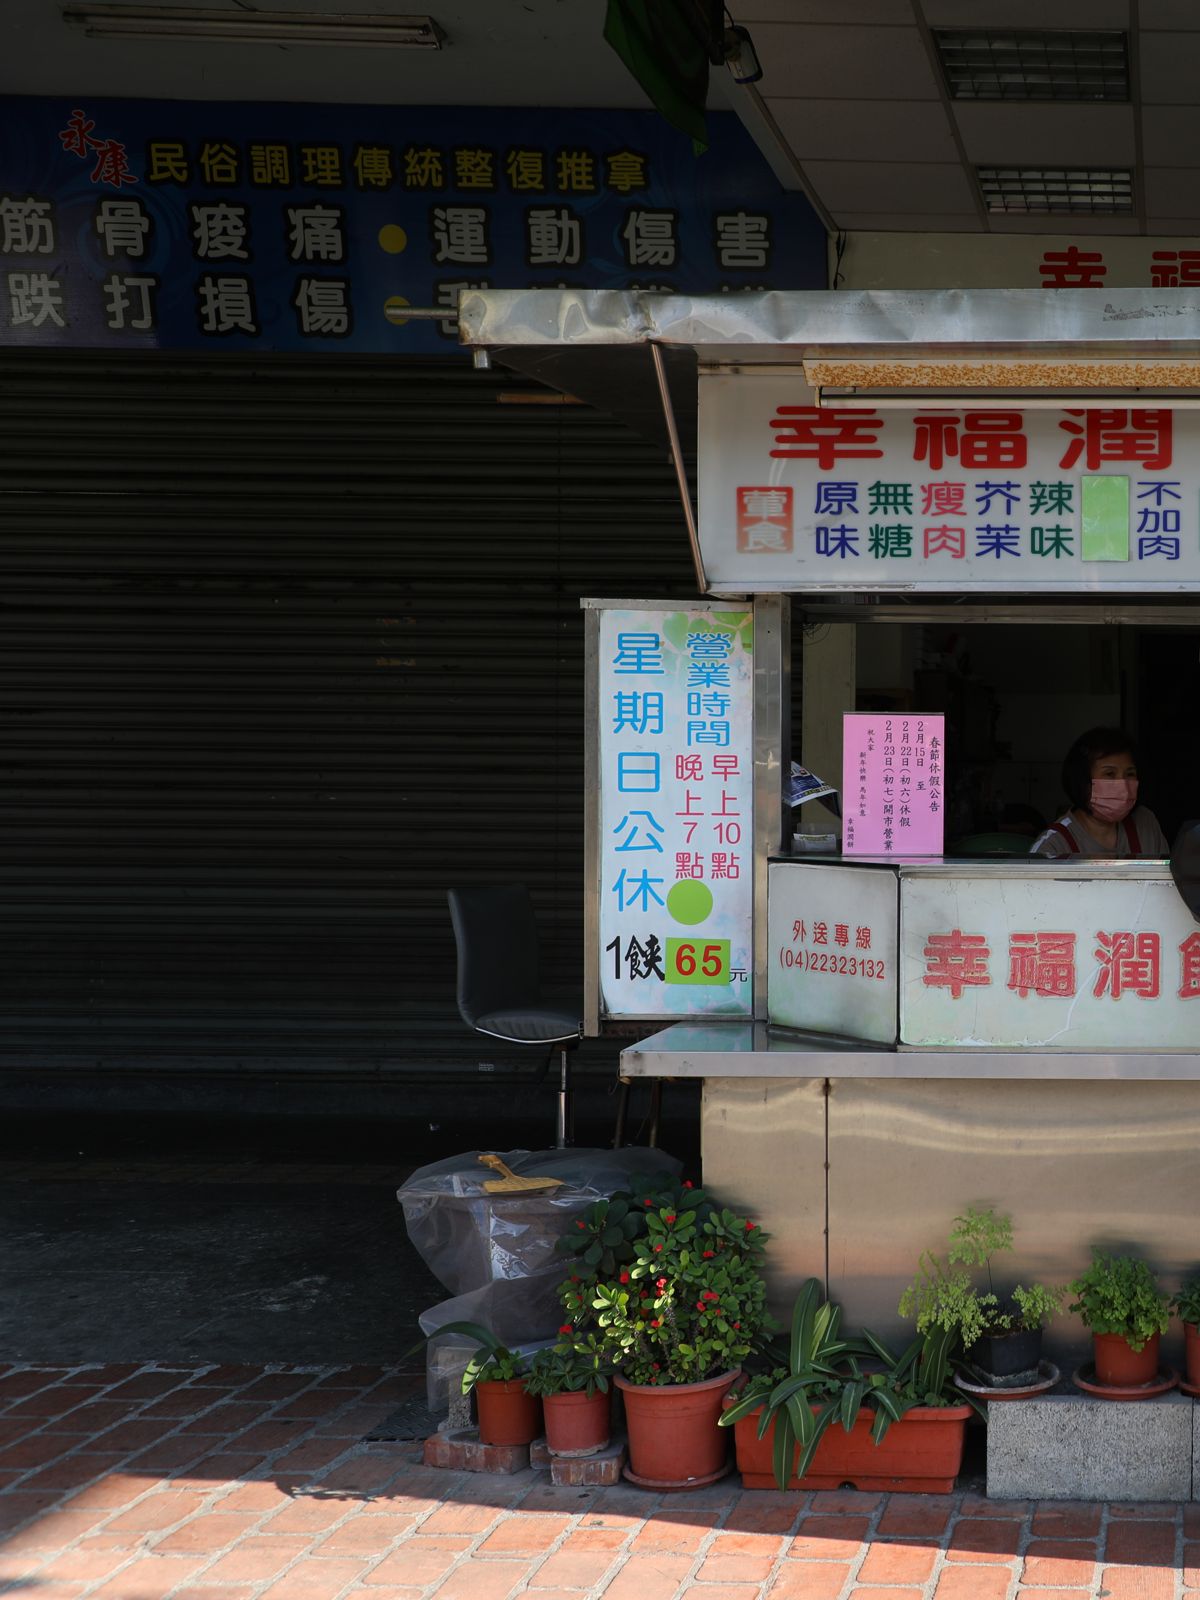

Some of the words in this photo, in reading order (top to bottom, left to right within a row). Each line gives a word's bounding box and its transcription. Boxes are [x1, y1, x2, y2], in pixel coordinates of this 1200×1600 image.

[58, 110, 140, 188] 永康
[149, 140, 648, 192] 民俗調理傳統整復推拿
[433, 207, 770, 267] 運動傷害
[10, 274, 349, 334] 跌打損傷
[743, 490, 787, 550] 葷食
[815, 482, 859, 558] 原味
[868, 480, 913, 559] 無糖
[921, 481, 967, 559] 瘦肉
[1029, 480, 1074, 558] 辣味
[1137, 482, 1181, 560] 不加肉
[687, 632, 732, 747] 營業時間
[612, 632, 665, 912] 星期日公休
[915, 721, 925, 767] 2月15日
[929, 736, 940, 812] 春節休假公告
[675, 754, 704, 879] 晚上7點
[711, 754, 741, 879] 早上10點
[916, 781, 926, 791] 至
[676, 944, 722, 976] 65
[729, 968, 747, 982] 元
[779, 946, 885, 979] (04)22323132
[792, 919, 871, 949] 外送專線
